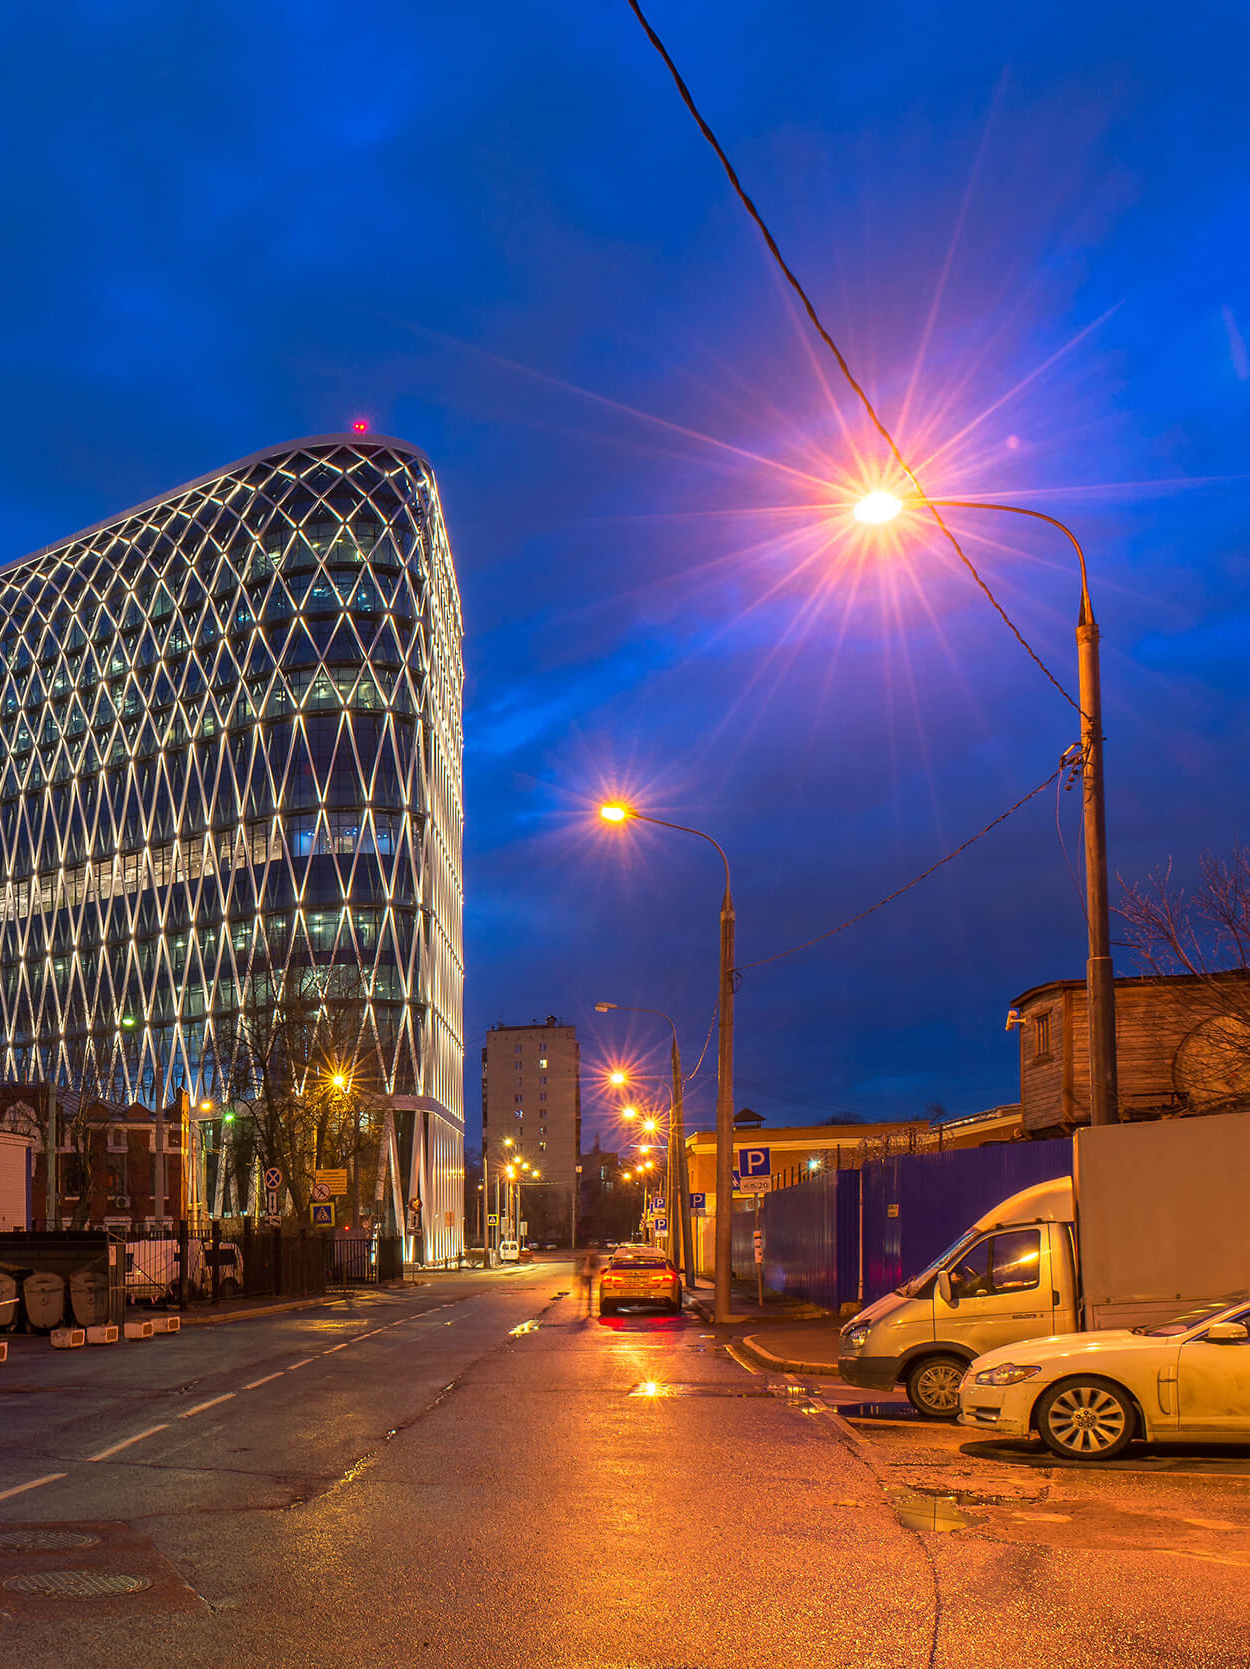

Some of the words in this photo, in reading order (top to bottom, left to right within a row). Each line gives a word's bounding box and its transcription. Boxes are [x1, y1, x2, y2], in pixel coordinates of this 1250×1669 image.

[747, 1151, 765, 1174] P
[656, 1199, 664, 1207] P
[693, 1194, 703, 1207] P
[657, 1219, 666, 1229] P
